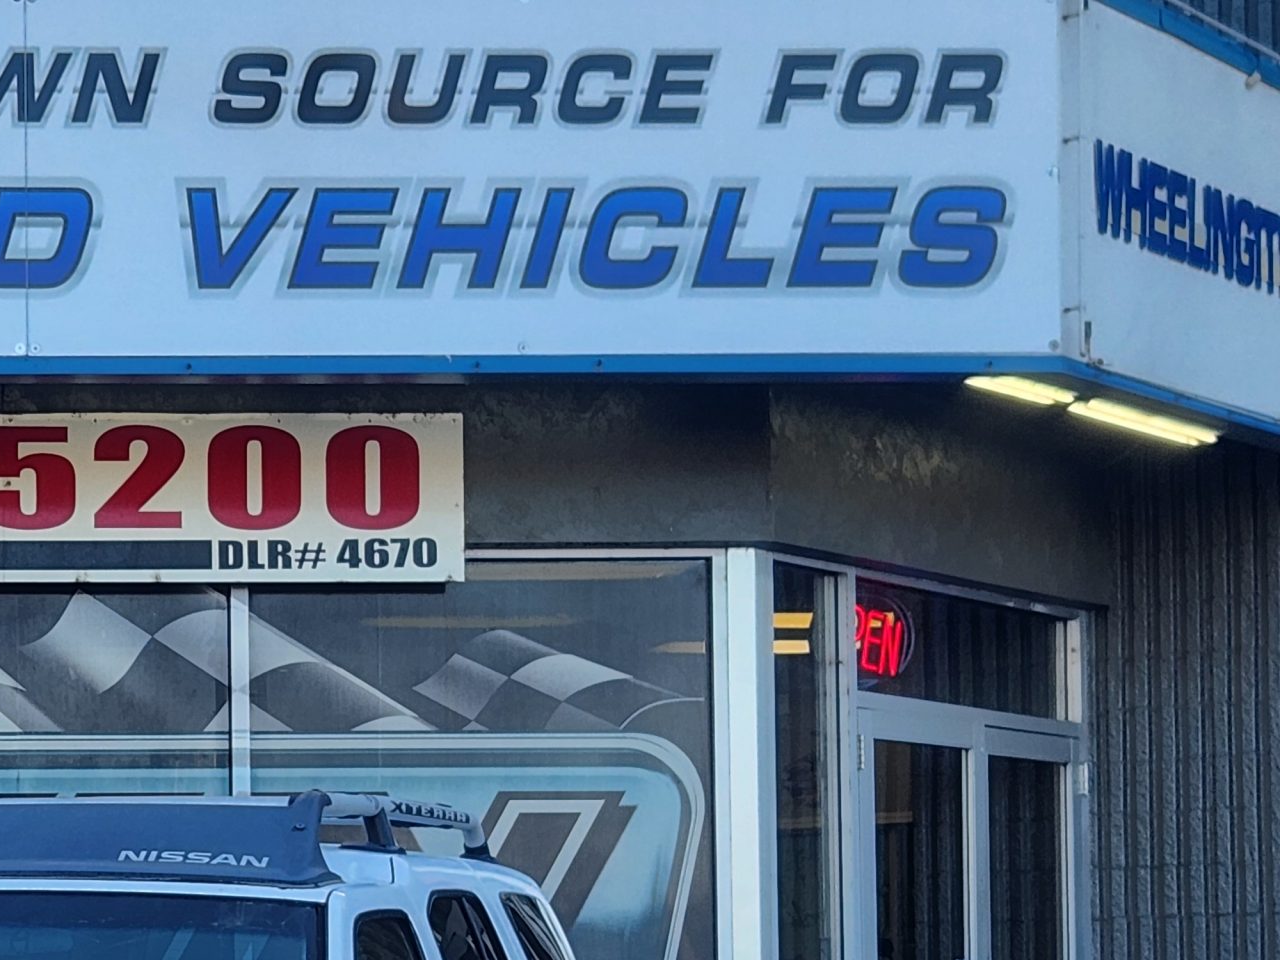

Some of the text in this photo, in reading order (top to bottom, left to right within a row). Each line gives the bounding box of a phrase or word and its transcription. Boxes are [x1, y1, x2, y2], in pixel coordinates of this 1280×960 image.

[212, 51, 715, 126] SOURCE
[765, 52, 1005, 125] FOR
[184, 185, 1007, 290] VEHICLES
[218, 537, 438, 570] DLR# 4670
[855, 603, 903, 677] PEN
[117, 849, 270, 868] NISSAN
